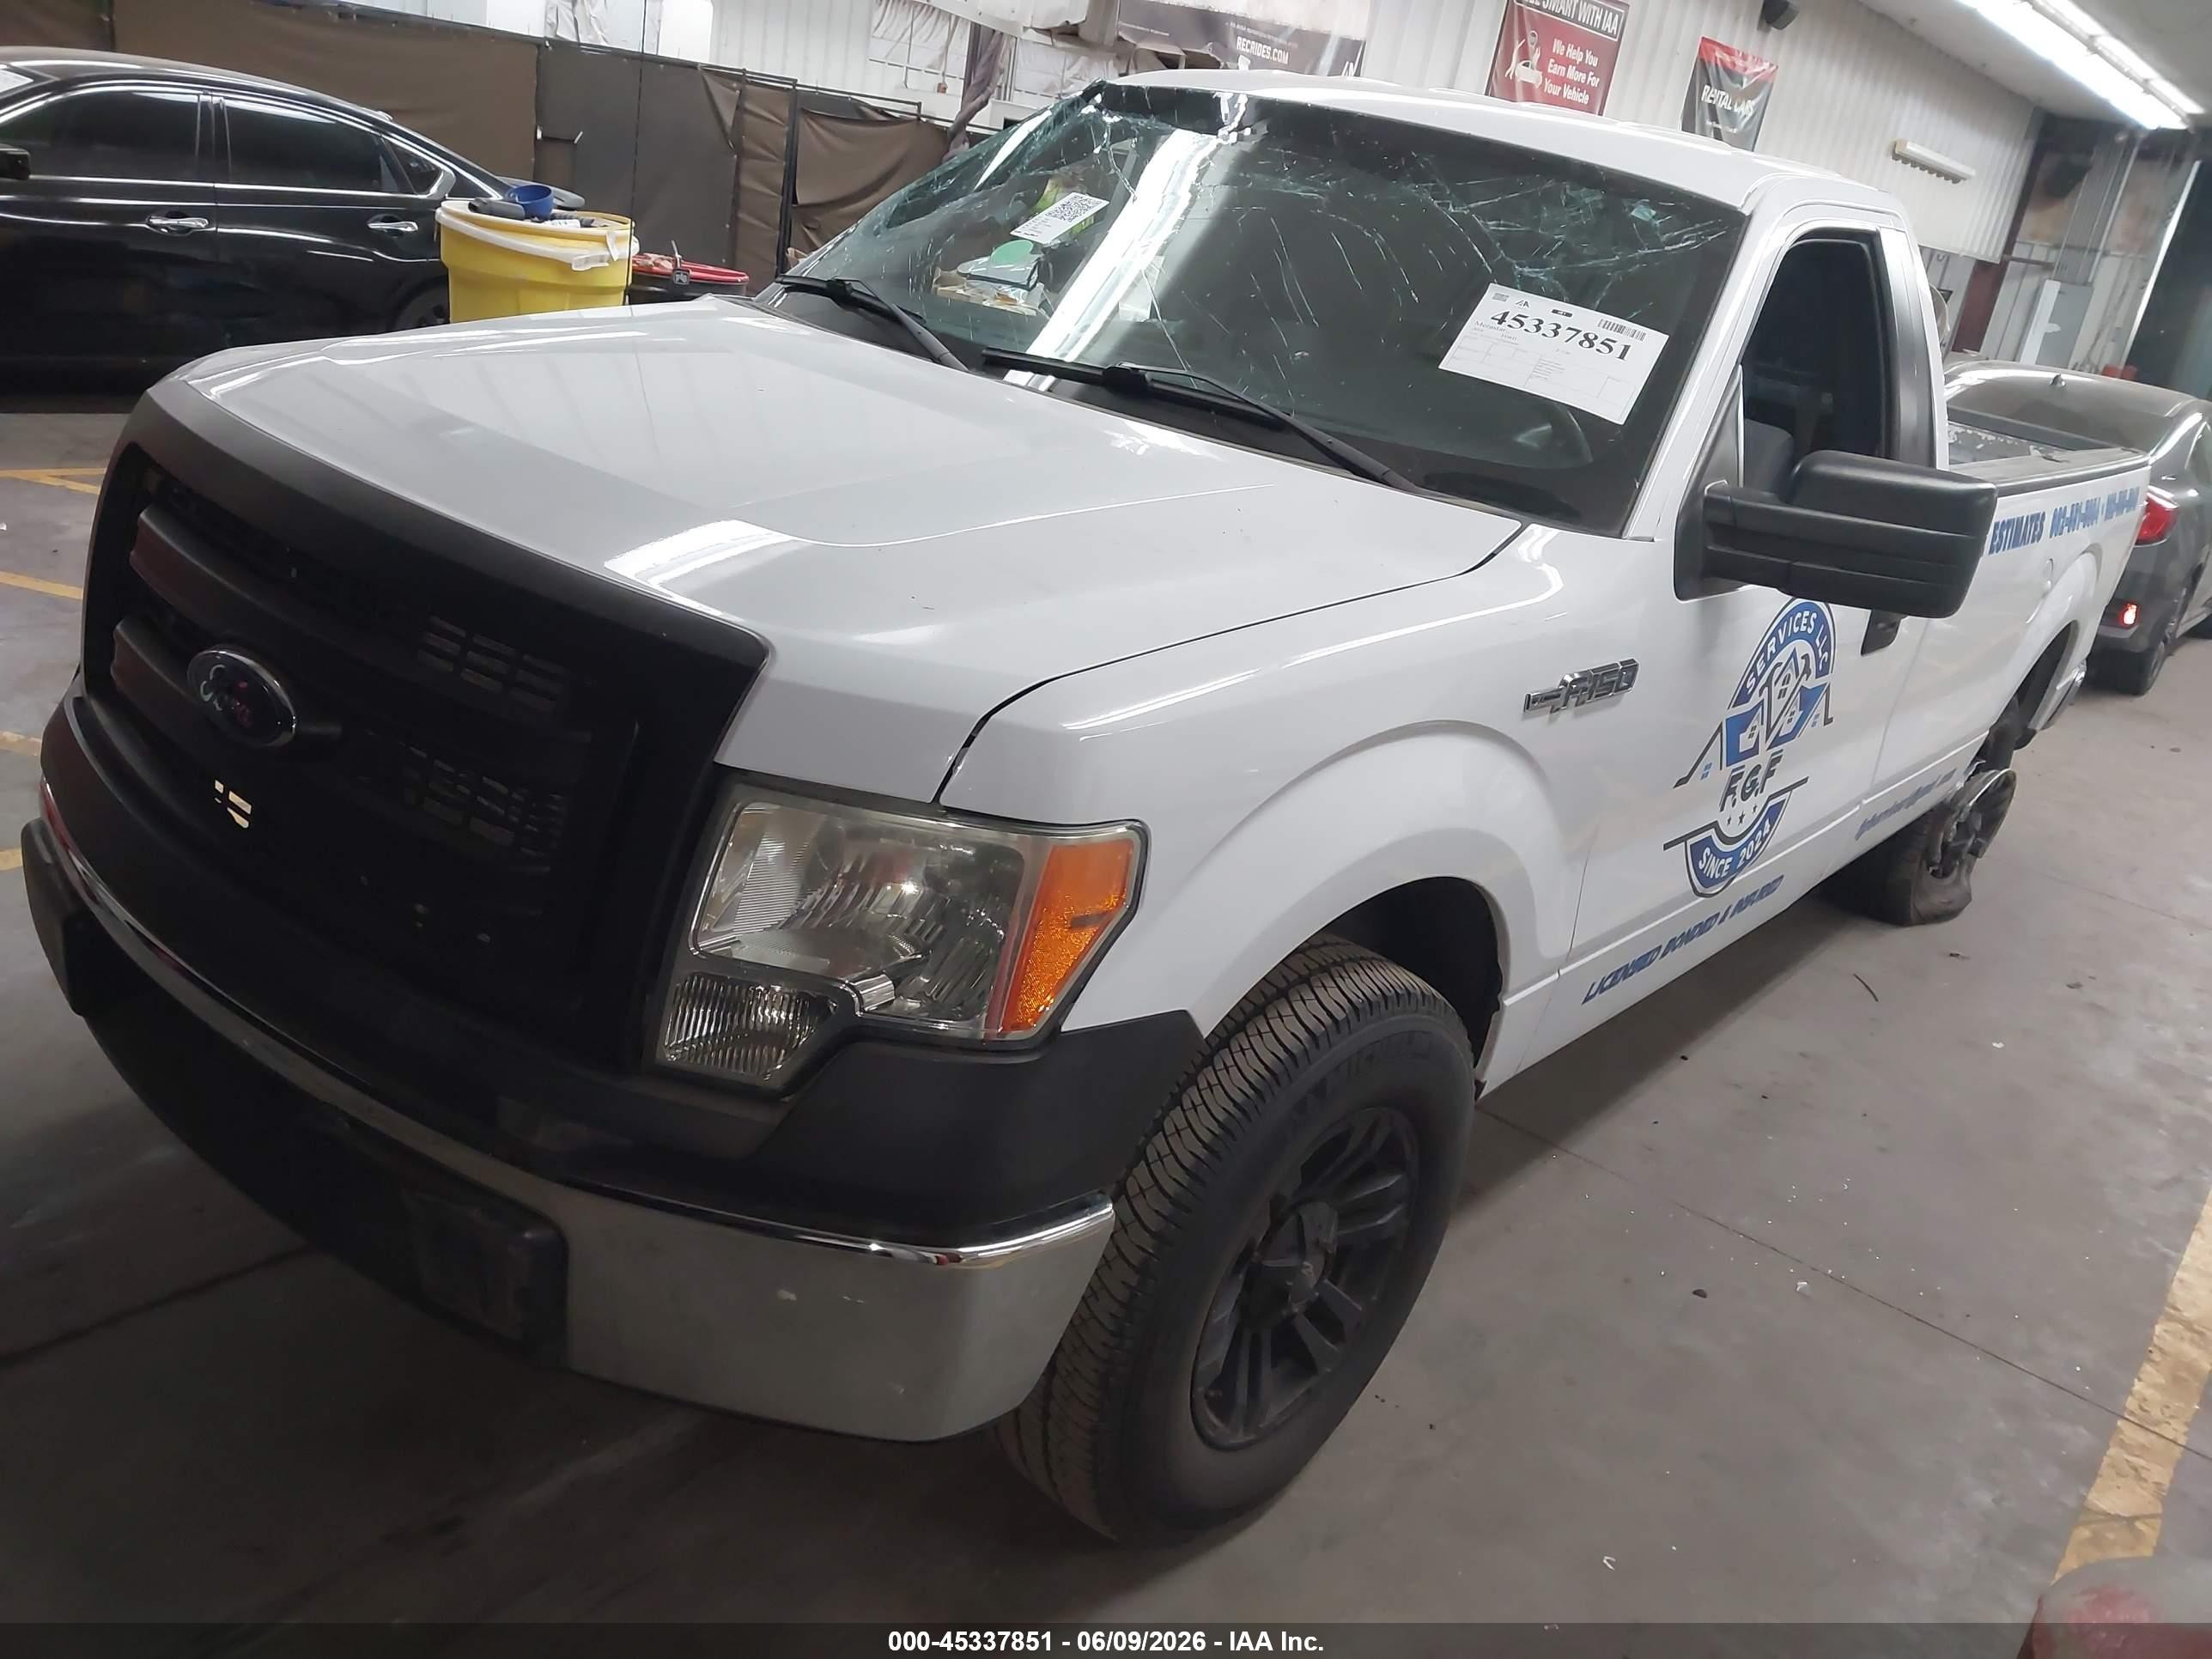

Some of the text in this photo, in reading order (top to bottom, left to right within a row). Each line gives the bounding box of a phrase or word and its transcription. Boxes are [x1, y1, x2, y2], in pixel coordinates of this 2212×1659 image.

[1578, 3, 1602, 28] WITH
[1601, 10, 1620, 34] IAA
[1237, 36, 1289, 64] RECRIDES.COM
[1553, 38, 1599, 67] We Help You
[1547, 58, 1600, 87] Earn More For
[1544, 77, 1589, 105] Your Vehicle
[1701, 84, 1732, 111] RENTAL
[1490, 310, 1632, 362] 45337851
[1989, 511, 2046, 556] ESTIMATES
[1746, 611, 1829, 696] SERVICES LLC
[1699, 818, 1771, 879] SINCE 2024
[1582, 945, 1662, 1005] LICENSED
